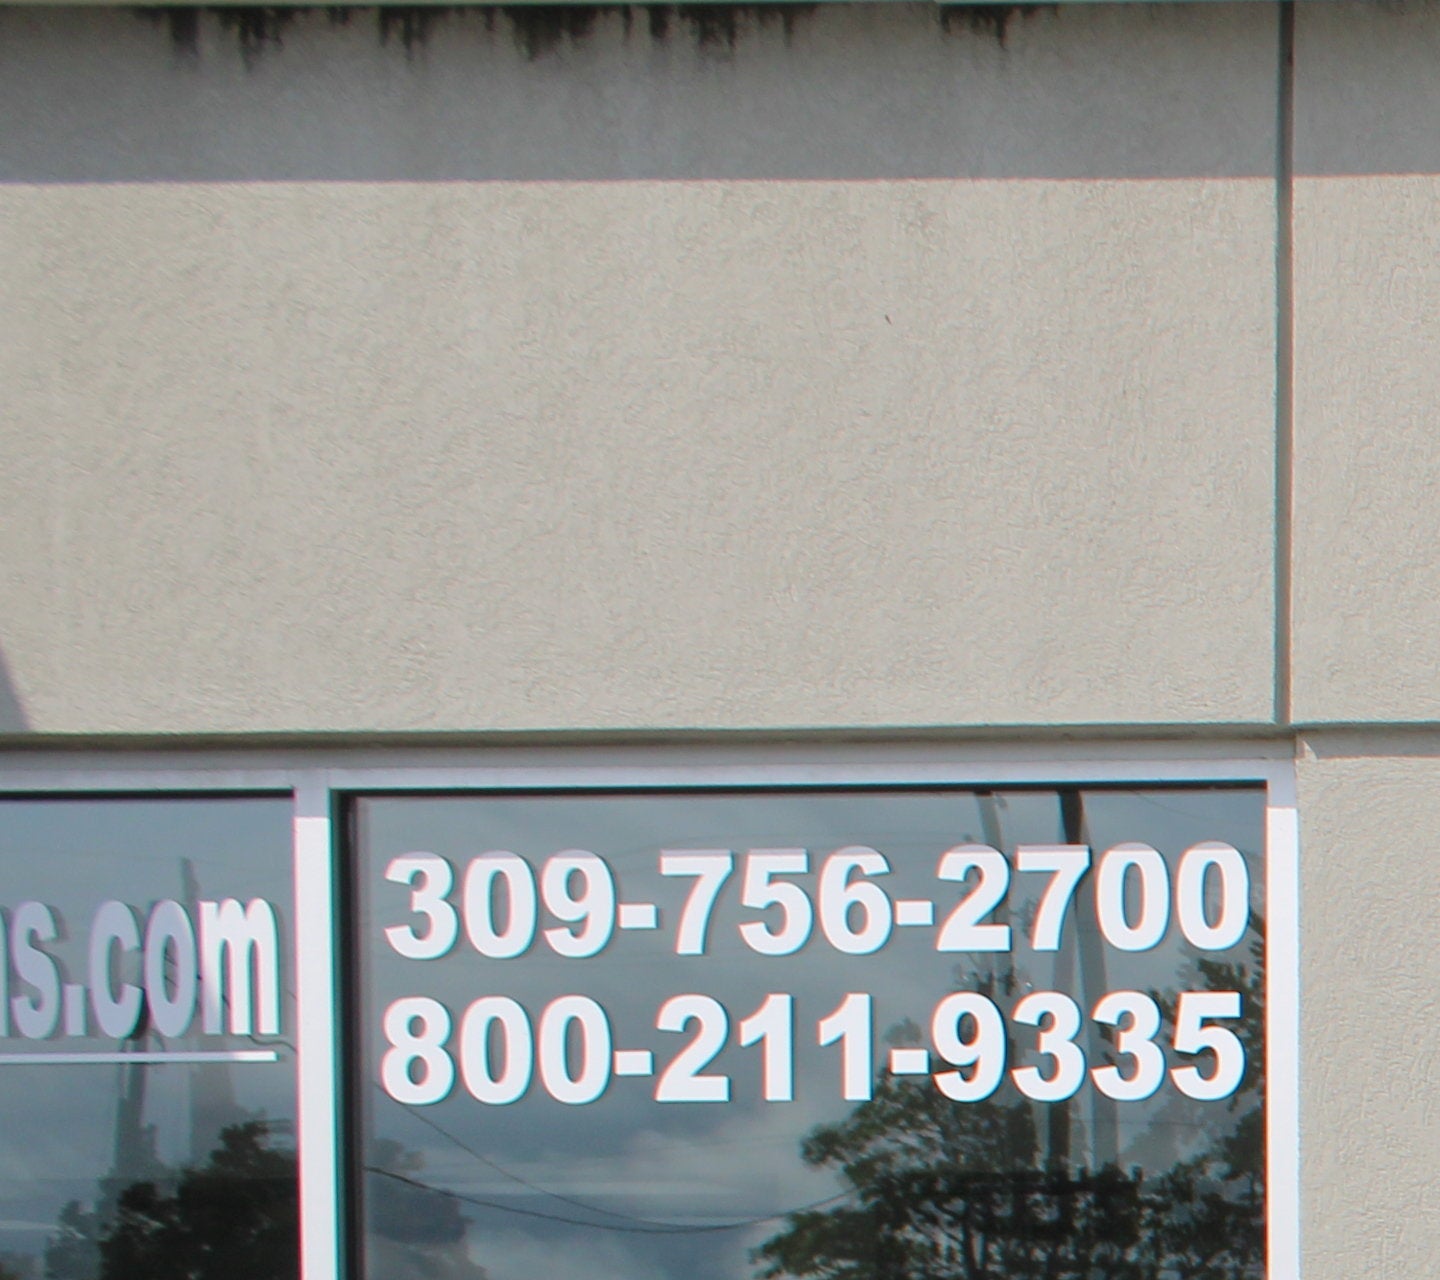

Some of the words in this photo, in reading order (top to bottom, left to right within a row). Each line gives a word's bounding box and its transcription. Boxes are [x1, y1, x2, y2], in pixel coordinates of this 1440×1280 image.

[384, 842, 1249, 959] 309-756-2700
[0, 897, 280, 1040] s.com
[381, 991, 1245, 1105] 800-211-9335
